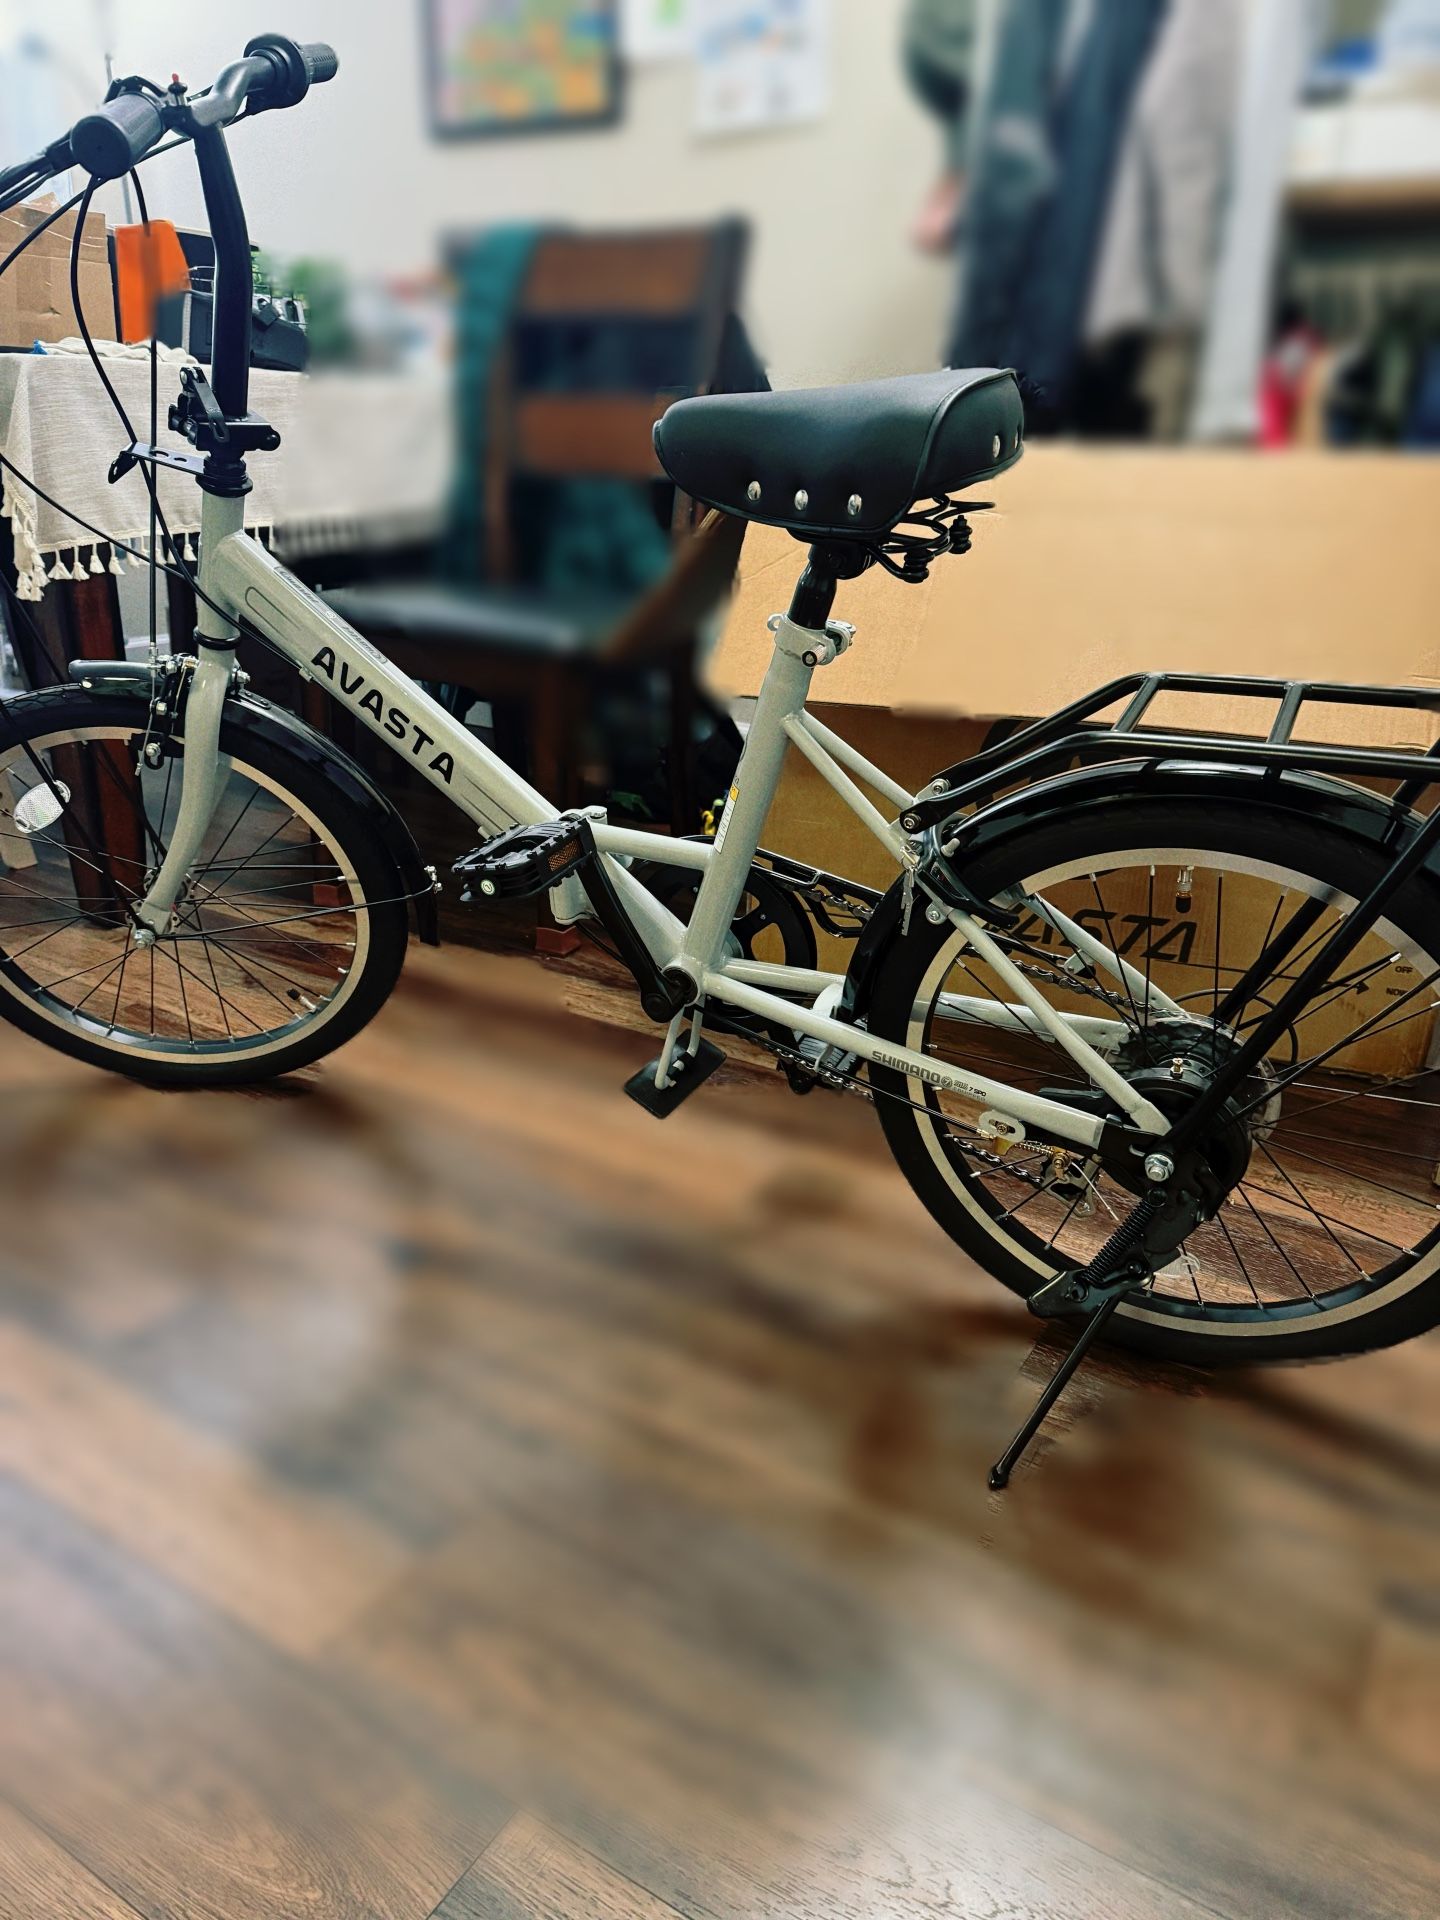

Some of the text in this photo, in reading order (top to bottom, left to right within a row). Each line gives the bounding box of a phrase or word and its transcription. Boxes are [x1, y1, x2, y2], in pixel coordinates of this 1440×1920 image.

[311, 646, 454, 784] AVASTA
[1394, 965, 1413, 974] OFF
[872, 1050, 941, 1084] SHIMANO
